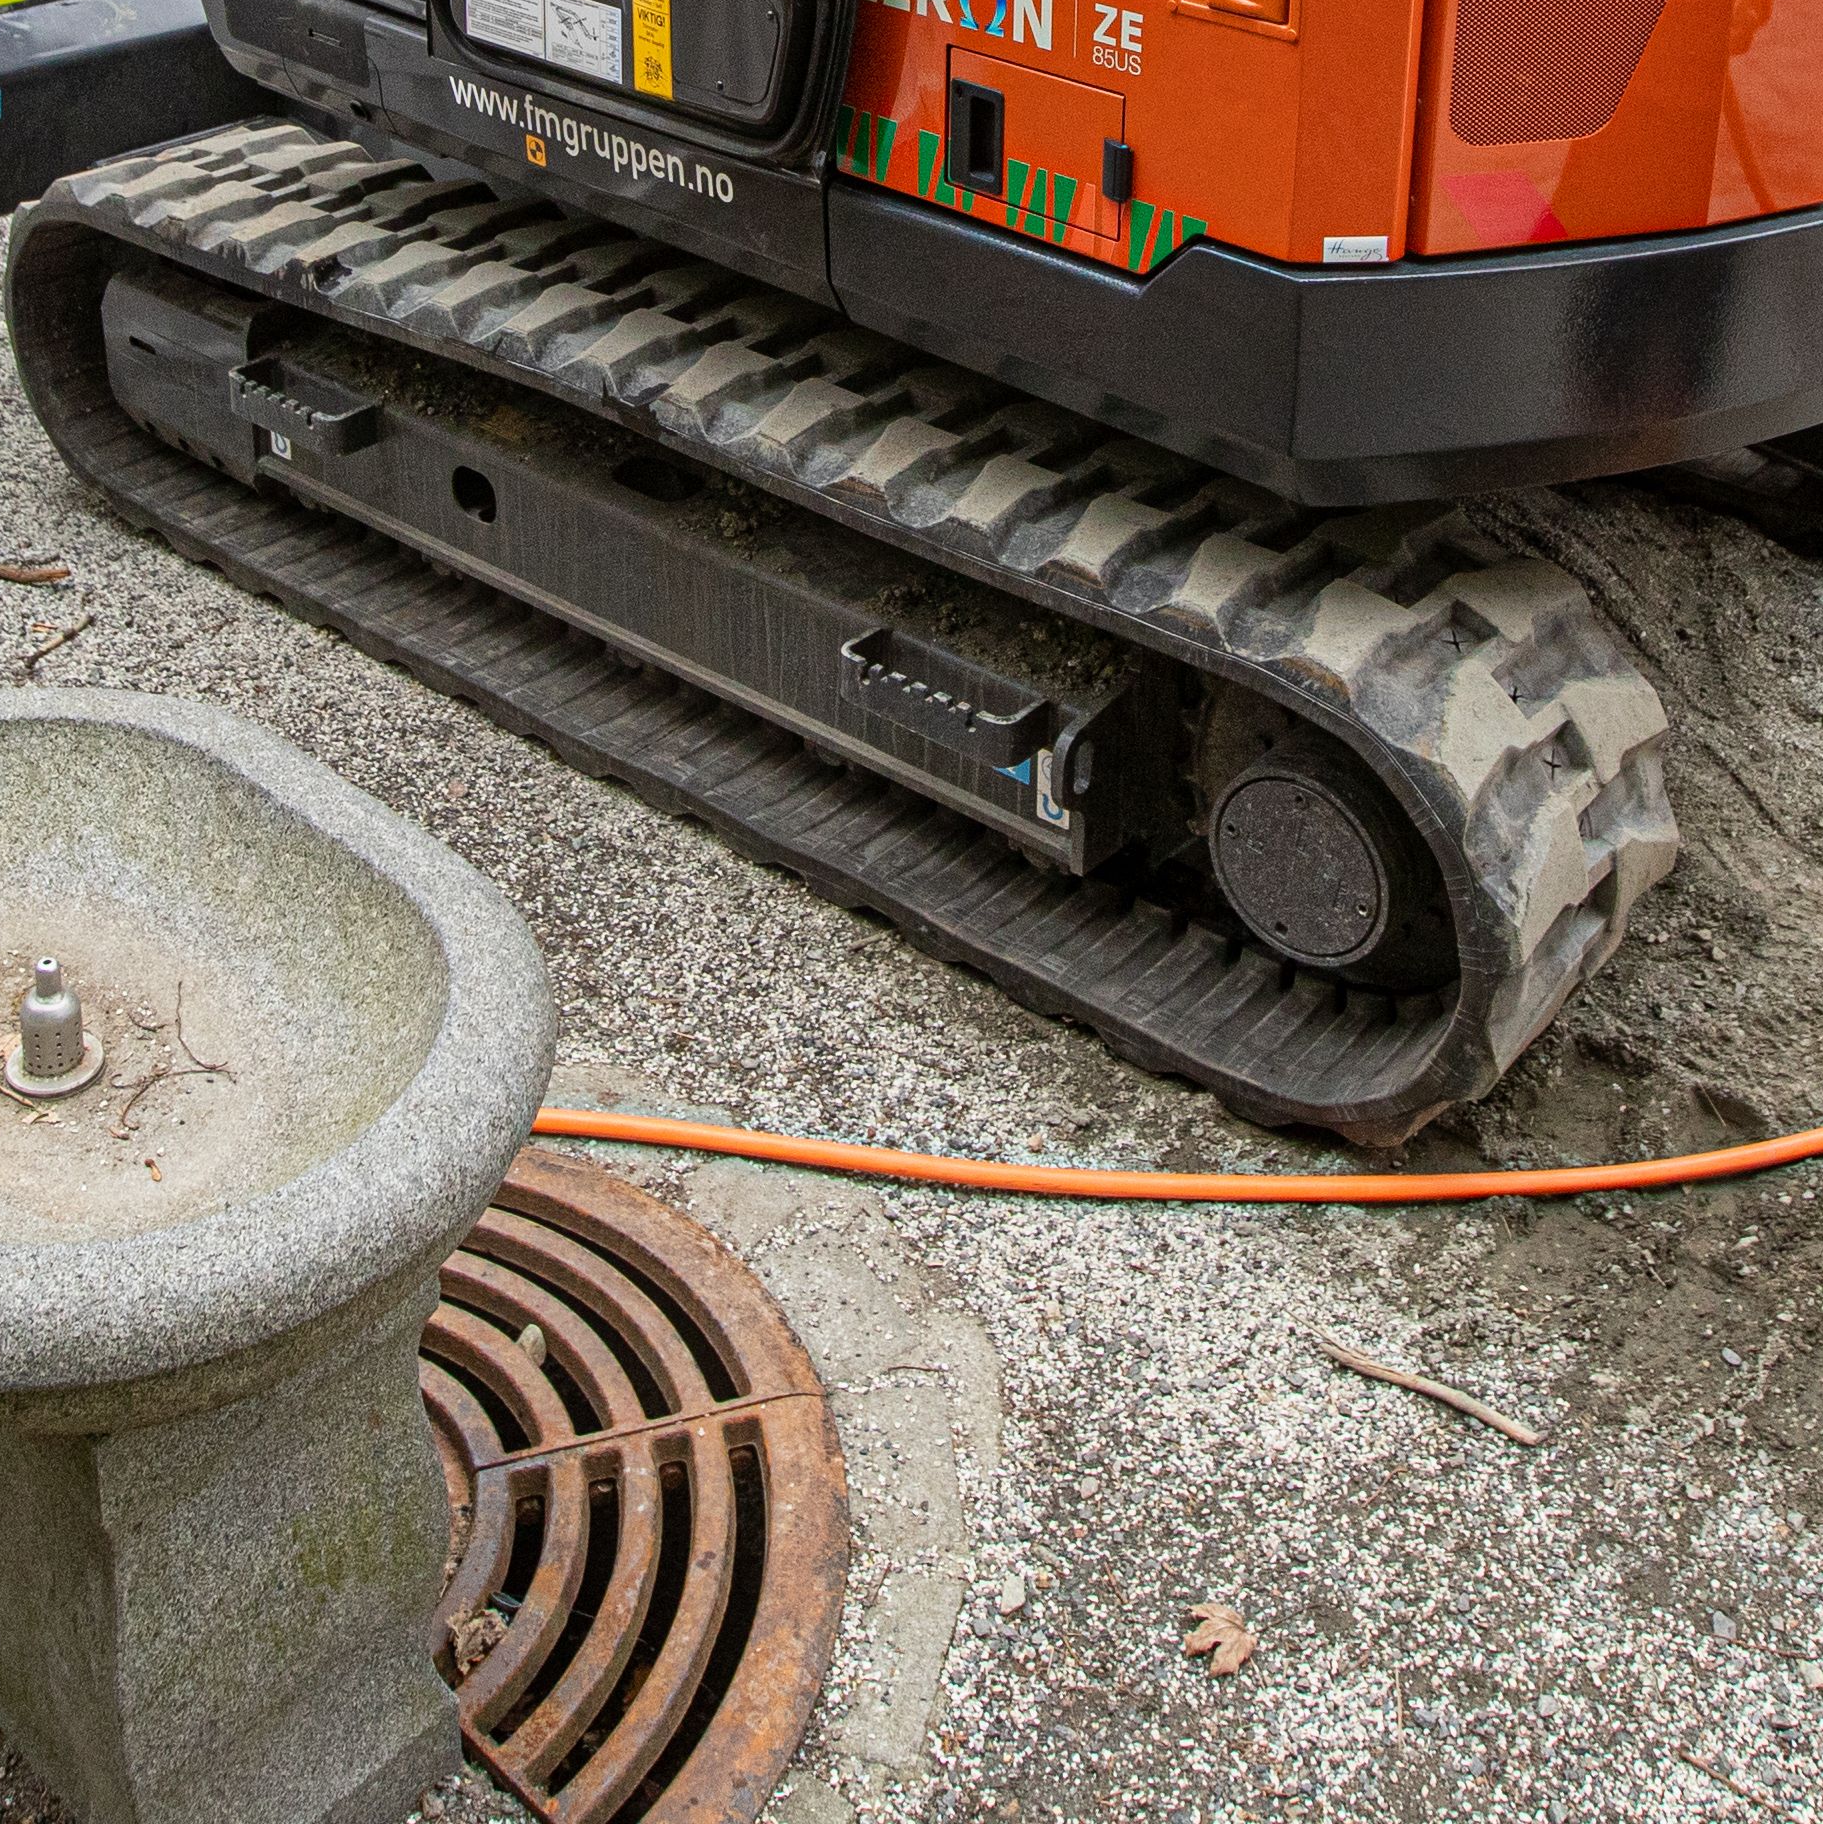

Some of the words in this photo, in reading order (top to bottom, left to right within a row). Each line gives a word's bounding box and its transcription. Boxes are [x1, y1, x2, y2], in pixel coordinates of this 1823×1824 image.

[637, 7, 665, 28] VIKTIG!
[1093, 4, 1143, 53] ZE
[1092, 45, 1142, 76] 85US
[448, 74, 734, 203] www.fmgruppen.no
